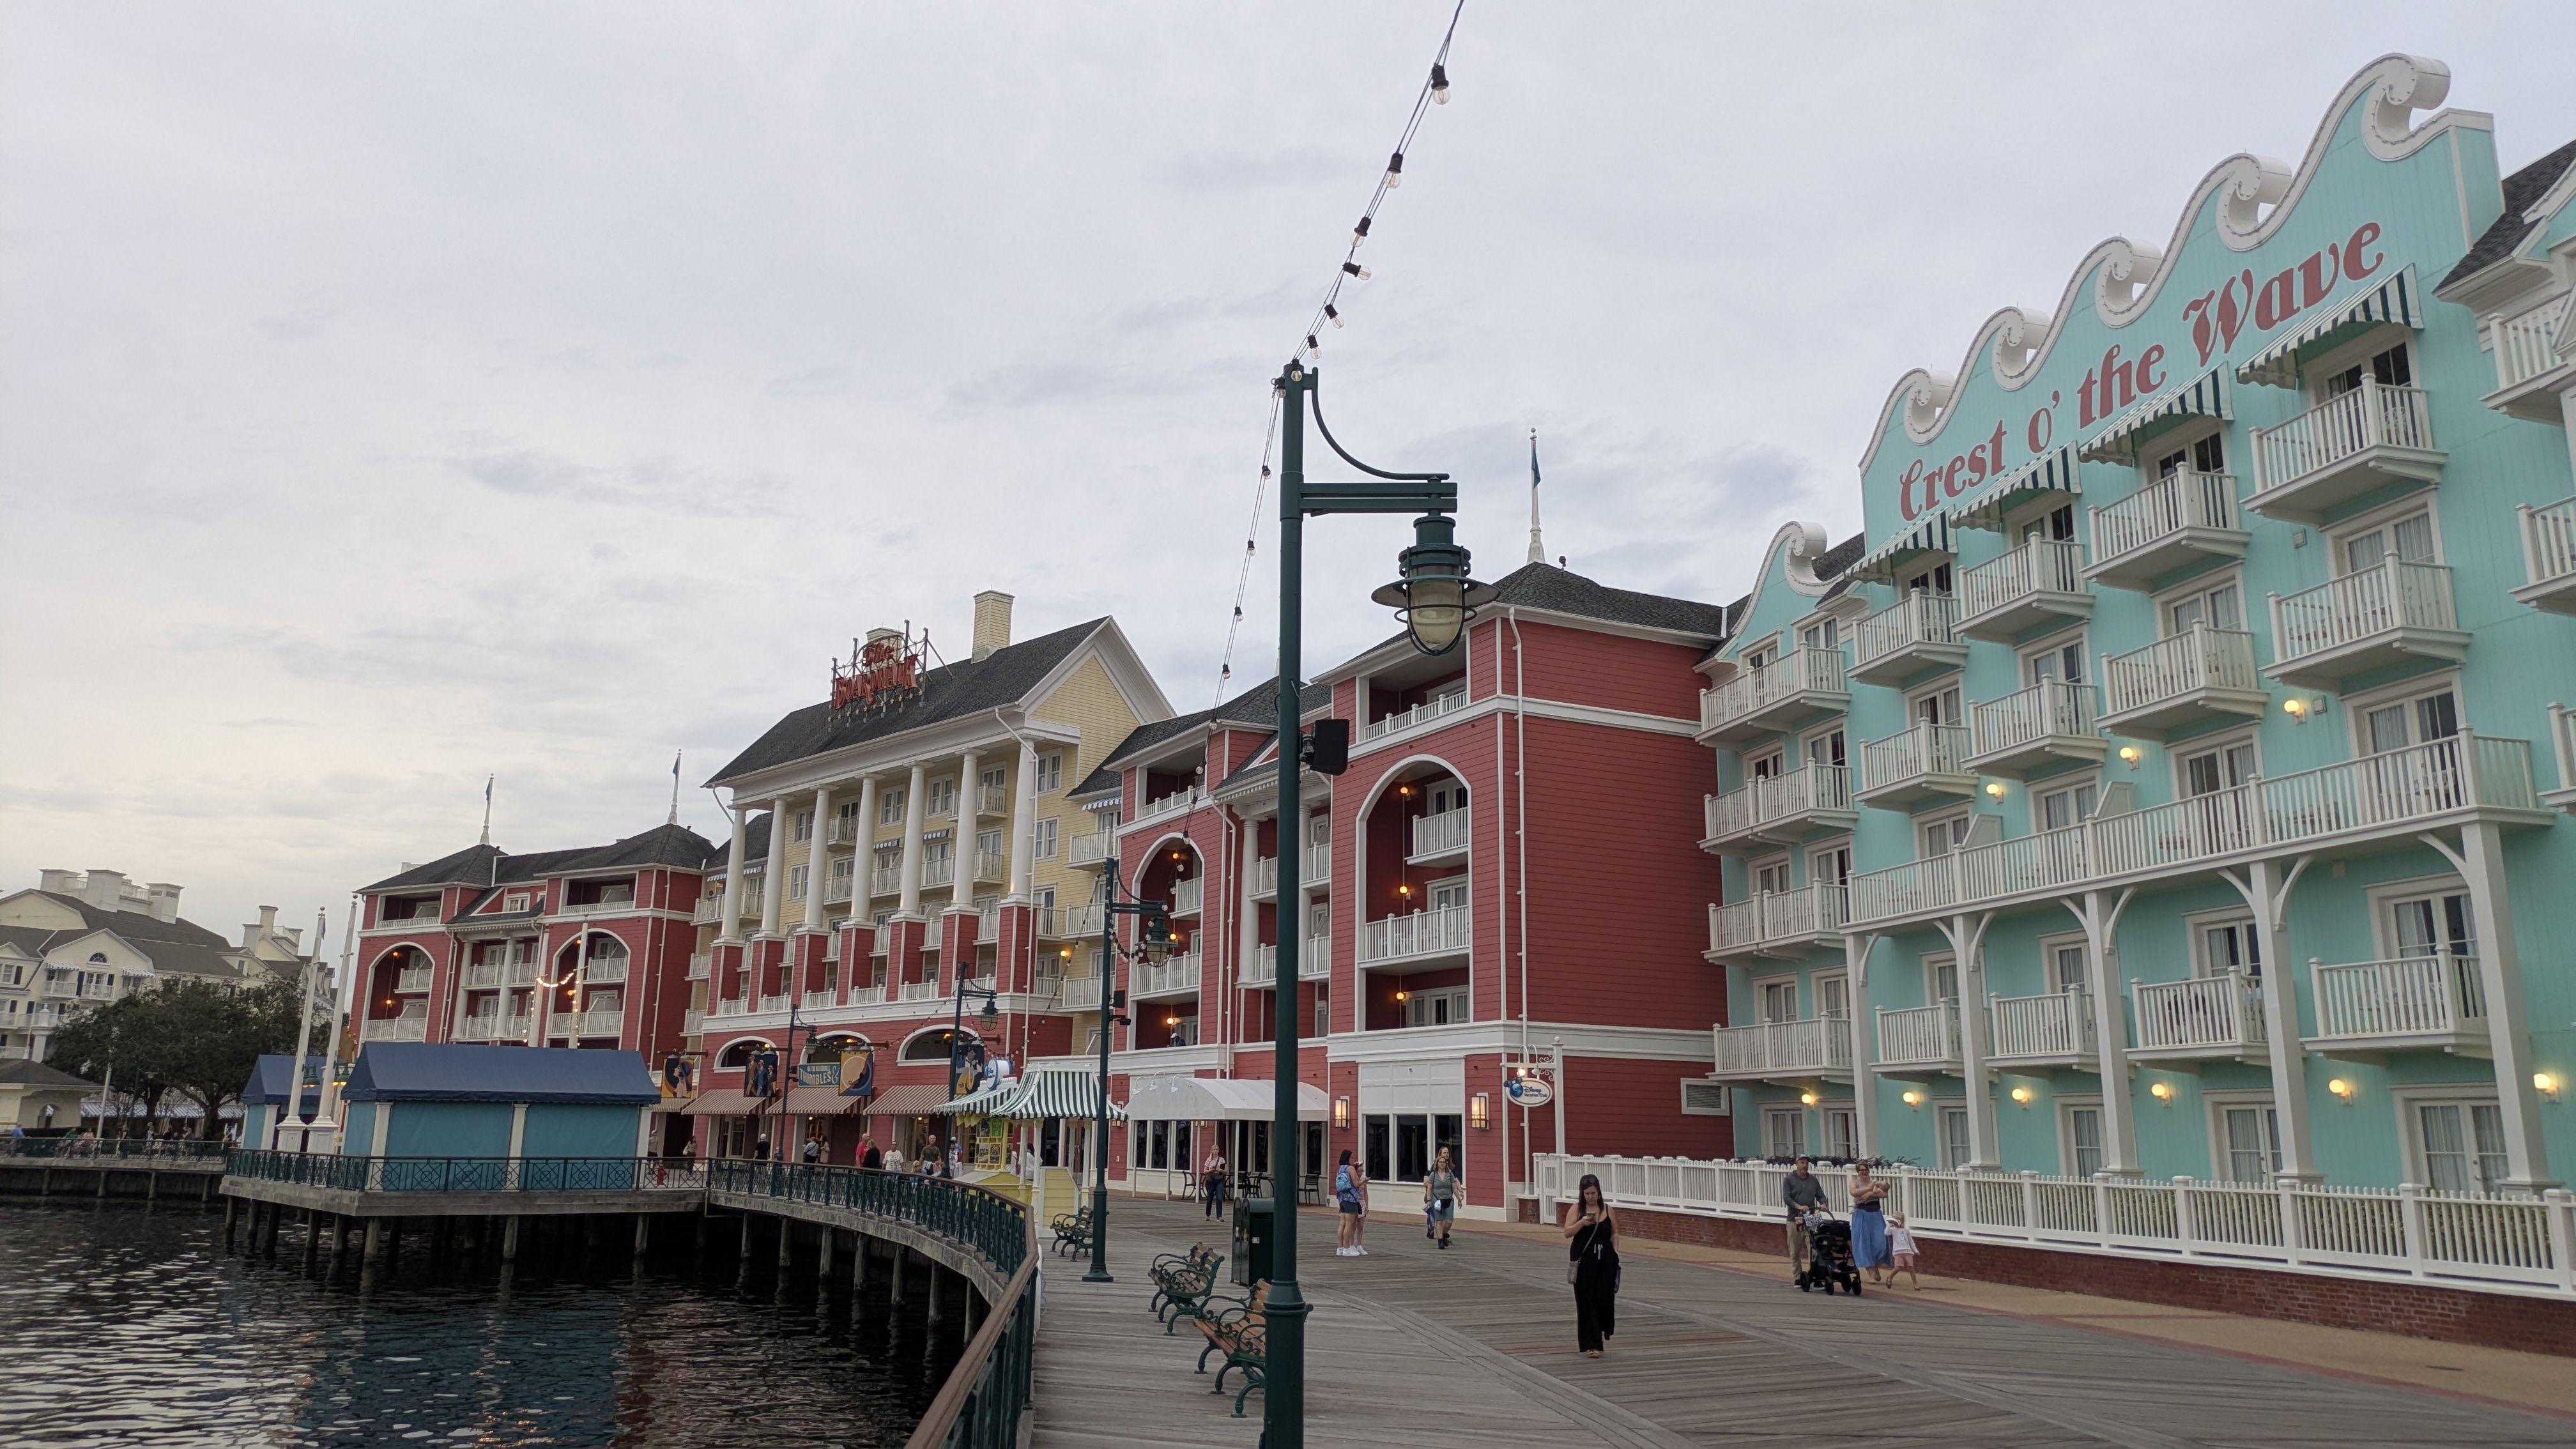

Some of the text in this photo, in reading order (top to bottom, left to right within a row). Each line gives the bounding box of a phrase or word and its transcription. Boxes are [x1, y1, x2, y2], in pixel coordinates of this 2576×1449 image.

[1900, 418, 2009, 521] Crest
[2078, 344, 2168, 429] the
[2182, 222, 2386, 367] Wave
[862, 642, 894, 667] The
[832, 654, 918, 710] BOARDWALK
[799, 1068, 832, 1085] THIMBLES
[1522, 1085, 1542, 1094] Disney
